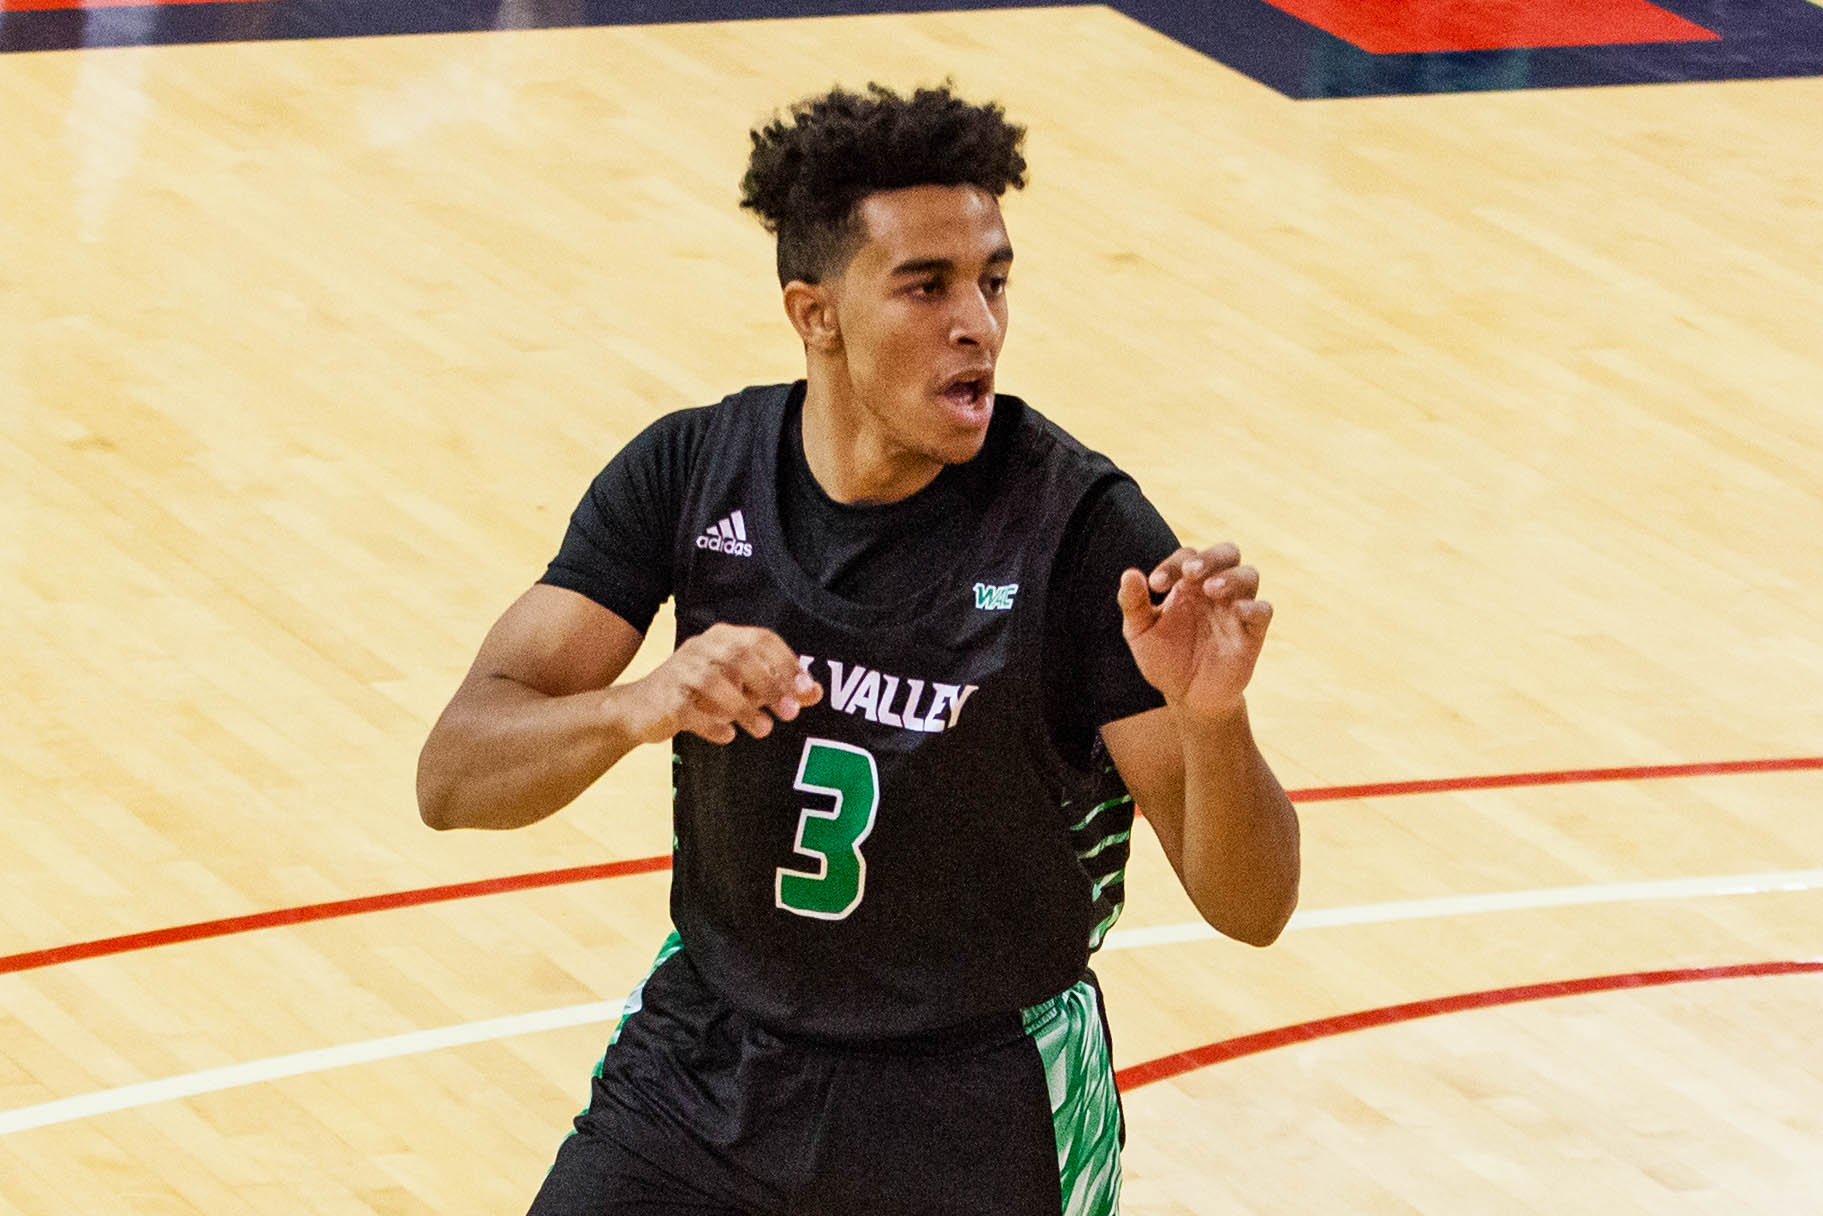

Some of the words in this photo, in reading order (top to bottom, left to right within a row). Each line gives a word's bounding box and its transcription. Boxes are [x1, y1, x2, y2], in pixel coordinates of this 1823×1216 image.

[696, 535, 753, 557] adidas
[972, 582, 1019, 610] WAC
[827, 659, 979, 733] VALLEY
[775, 737, 880, 921] 3
